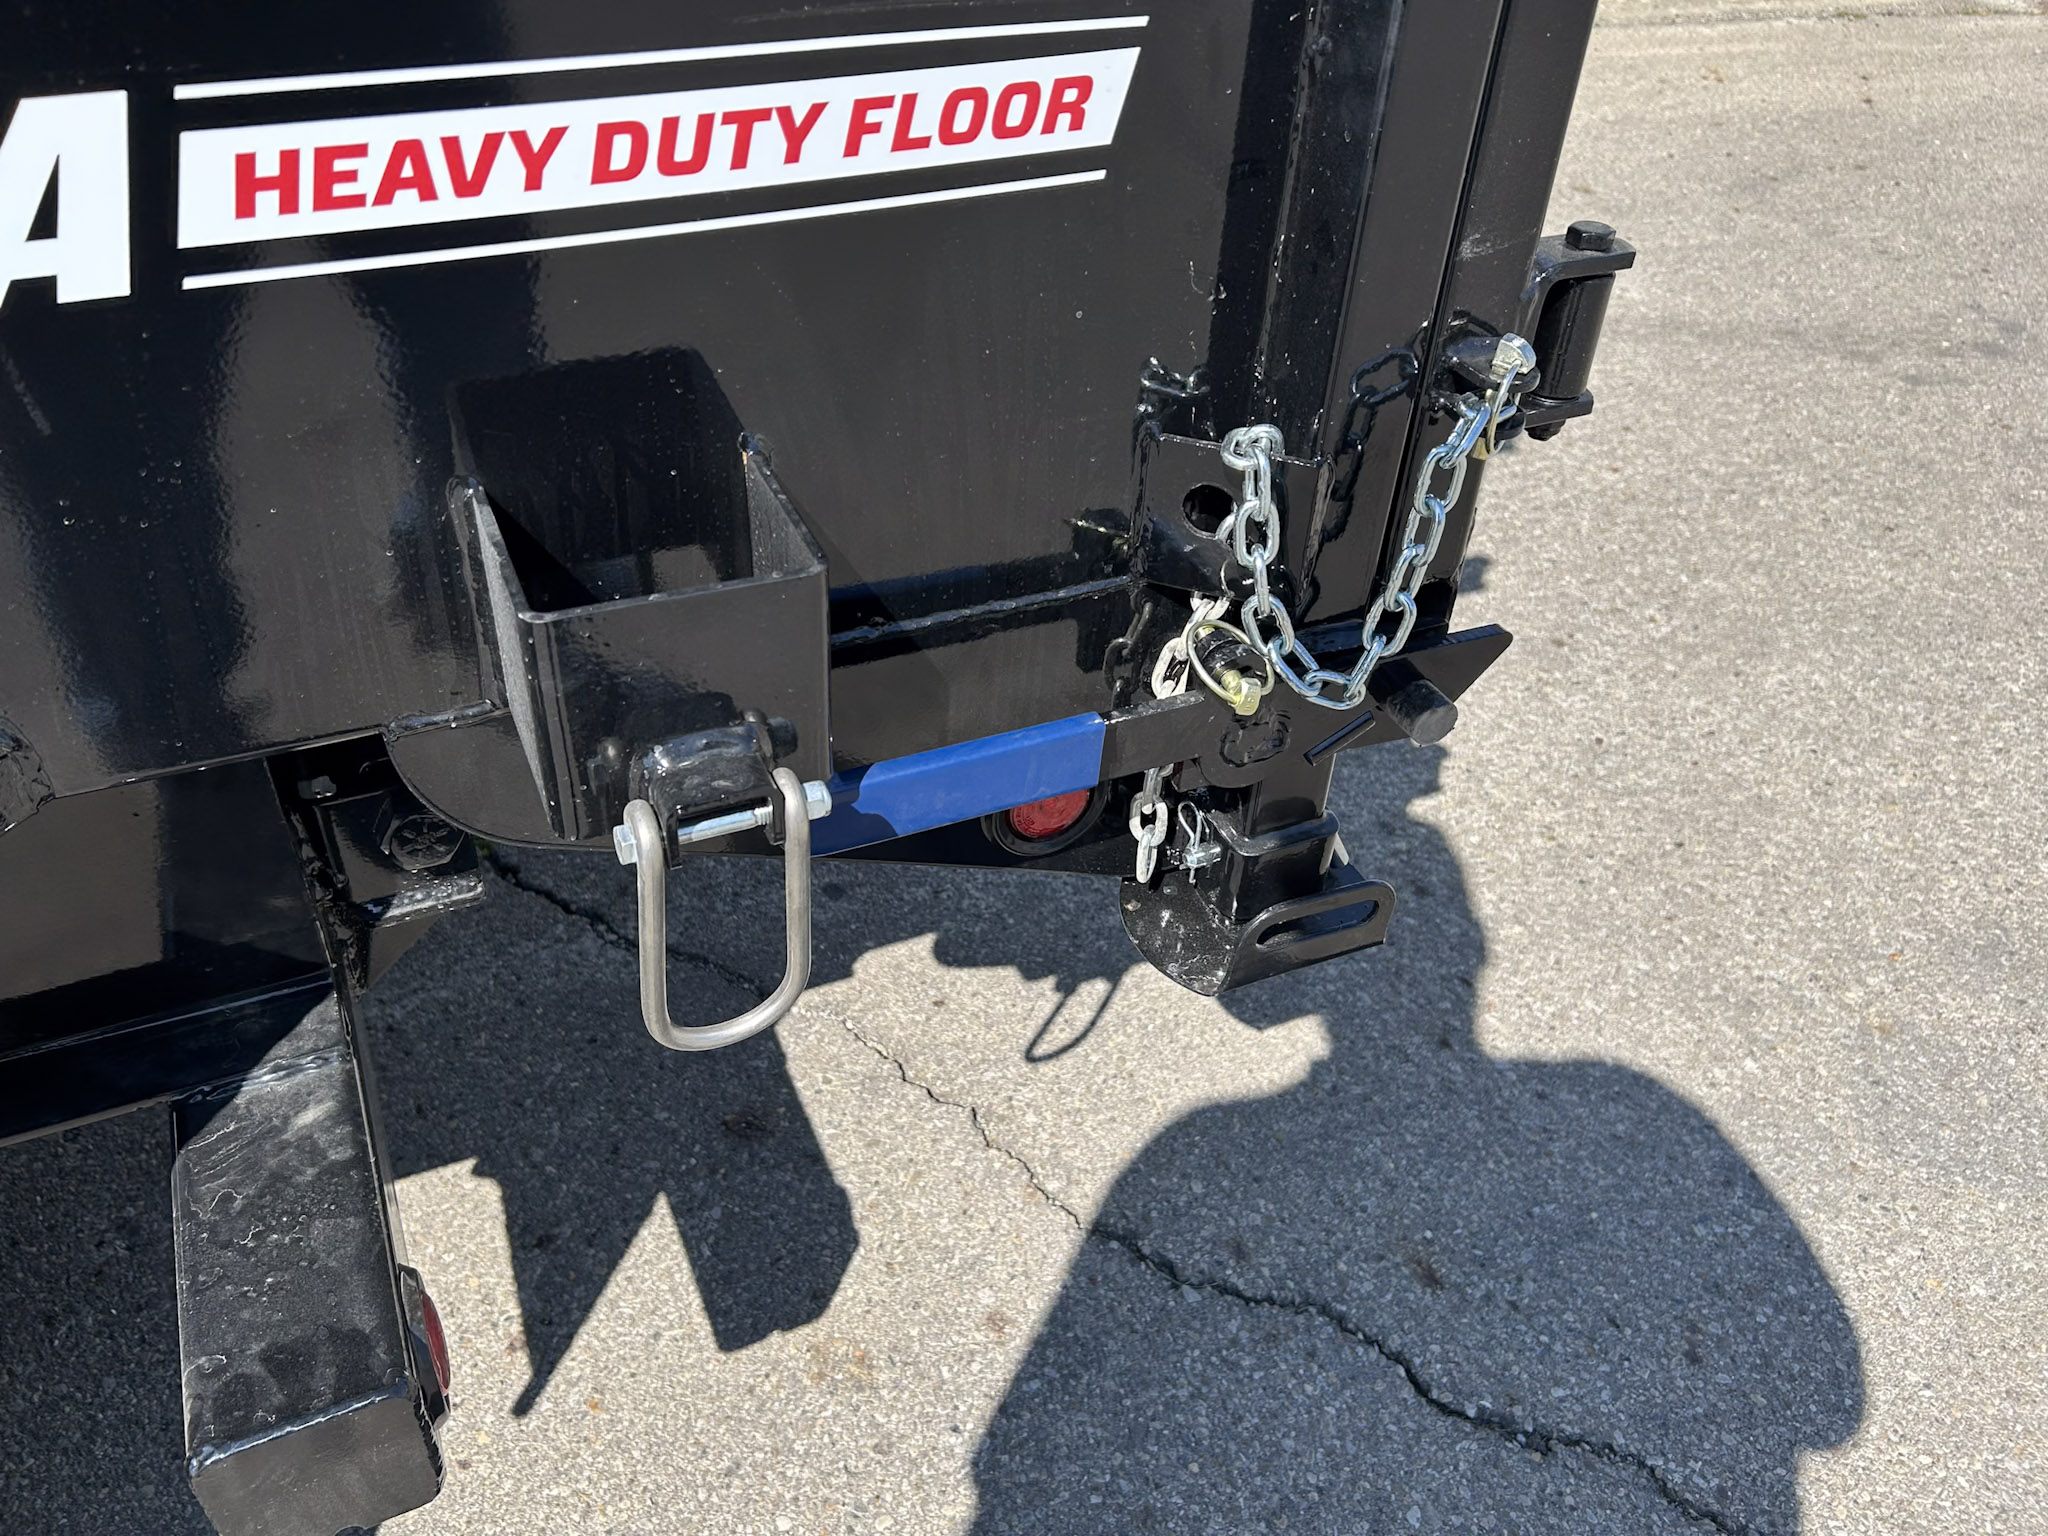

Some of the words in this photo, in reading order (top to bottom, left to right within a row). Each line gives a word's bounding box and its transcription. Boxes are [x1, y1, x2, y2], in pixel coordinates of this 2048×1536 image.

[235, 126, 569, 219] HEAVY
[590, 102, 828, 185] DUTY
[842, 75, 1094, 158] FLOOR
